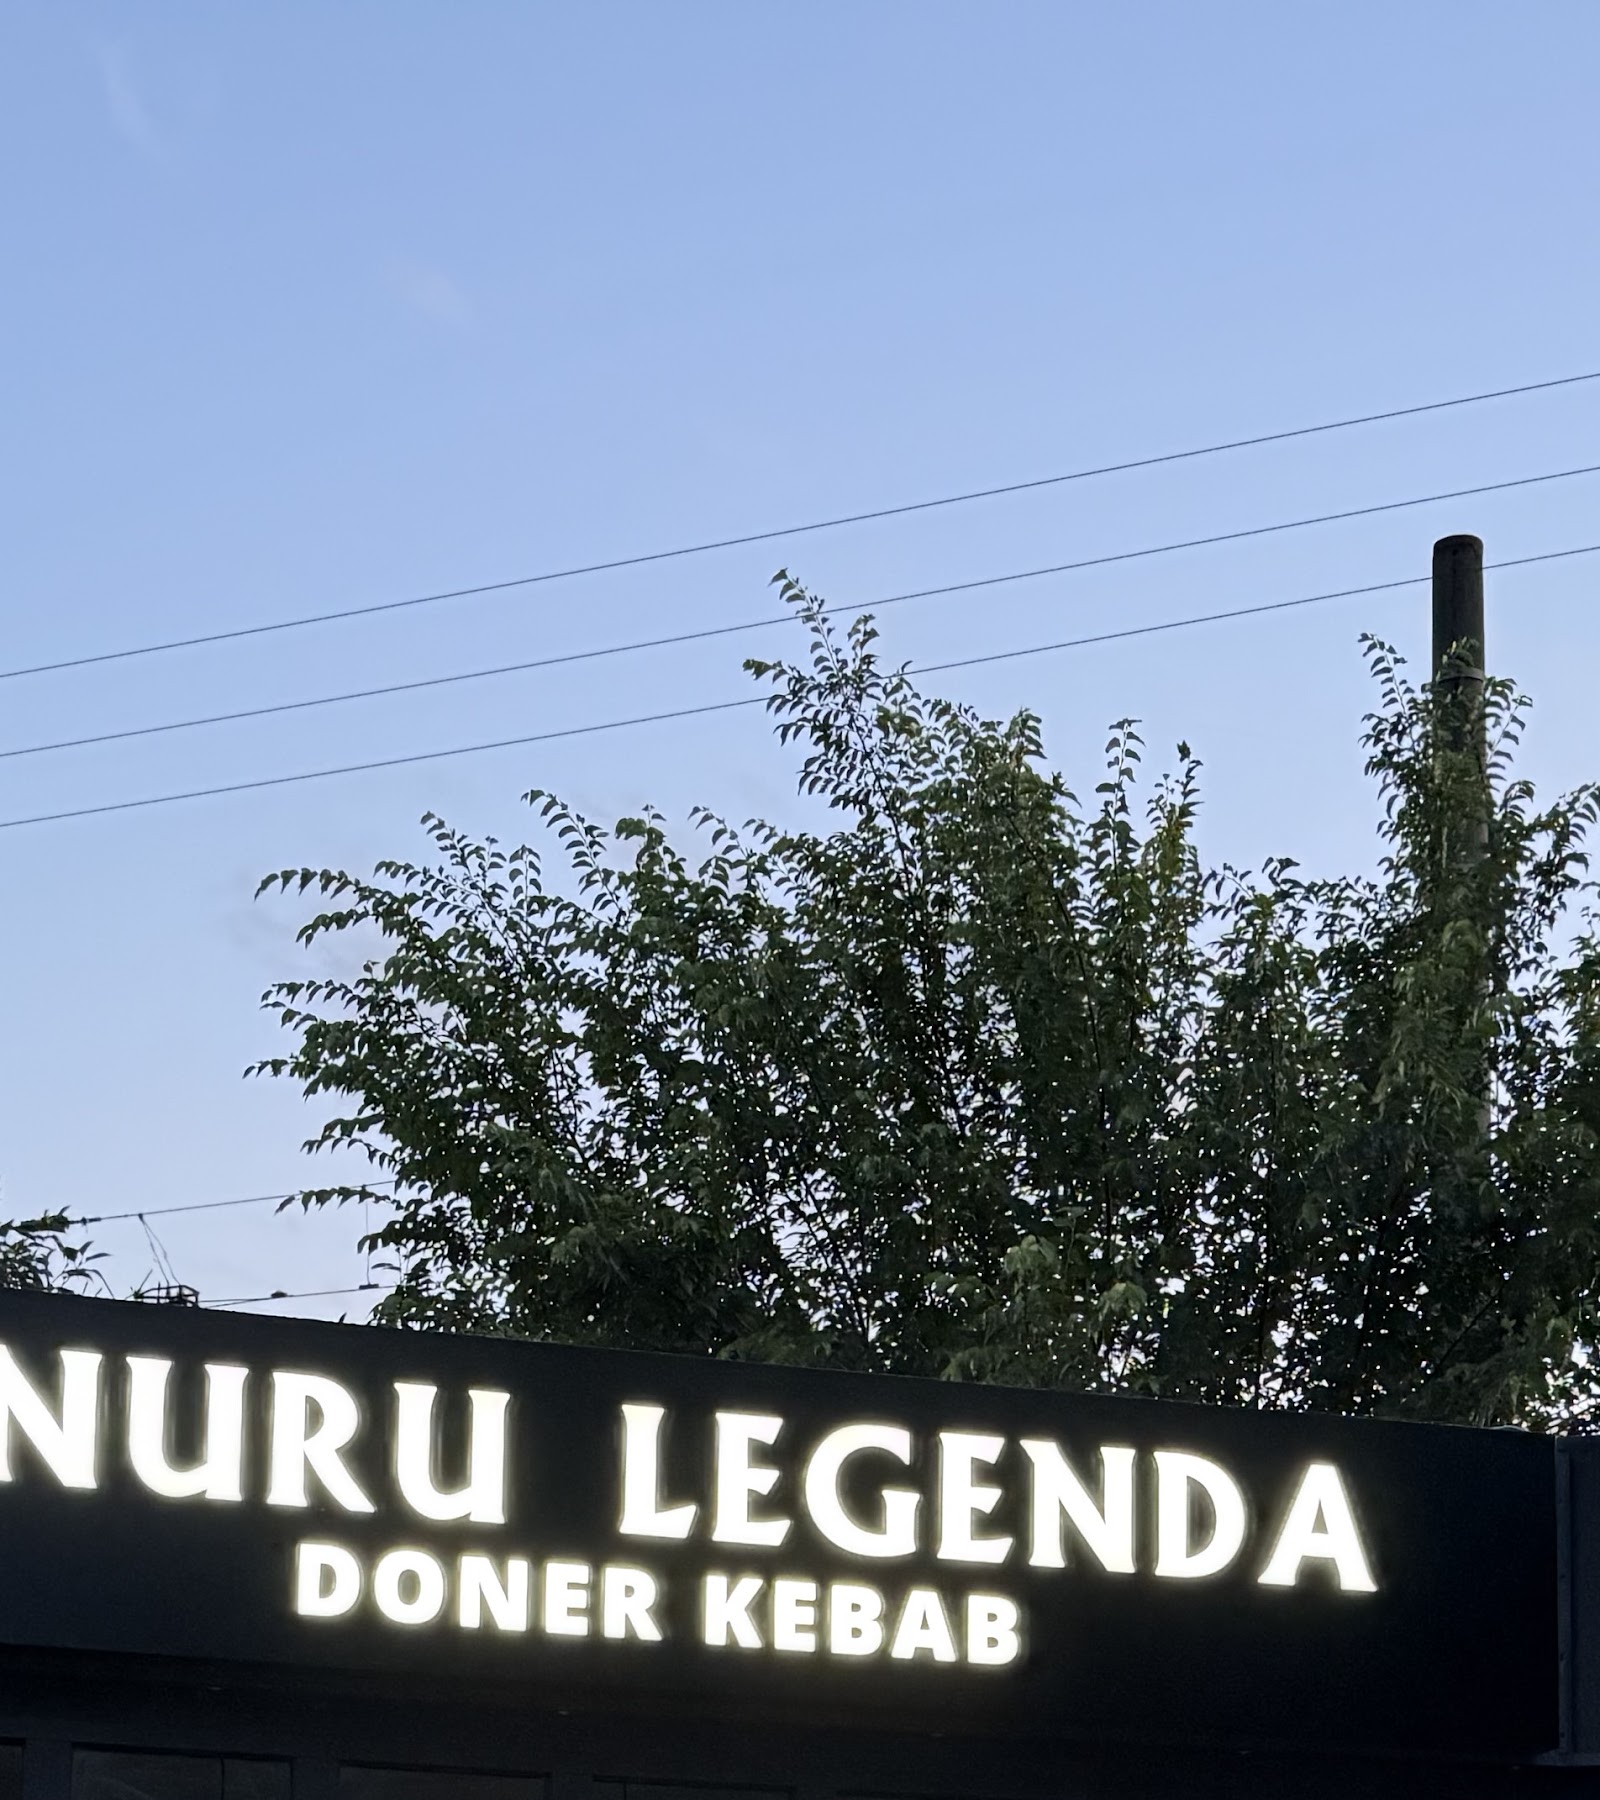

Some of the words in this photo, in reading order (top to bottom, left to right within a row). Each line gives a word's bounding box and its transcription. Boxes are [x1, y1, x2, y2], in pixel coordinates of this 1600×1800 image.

[617, 1401, 1379, 1594] LEGENDA
[294, 1540, 664, 1643] DONER
[701, 1572, 1021, 1667] KEBAB
